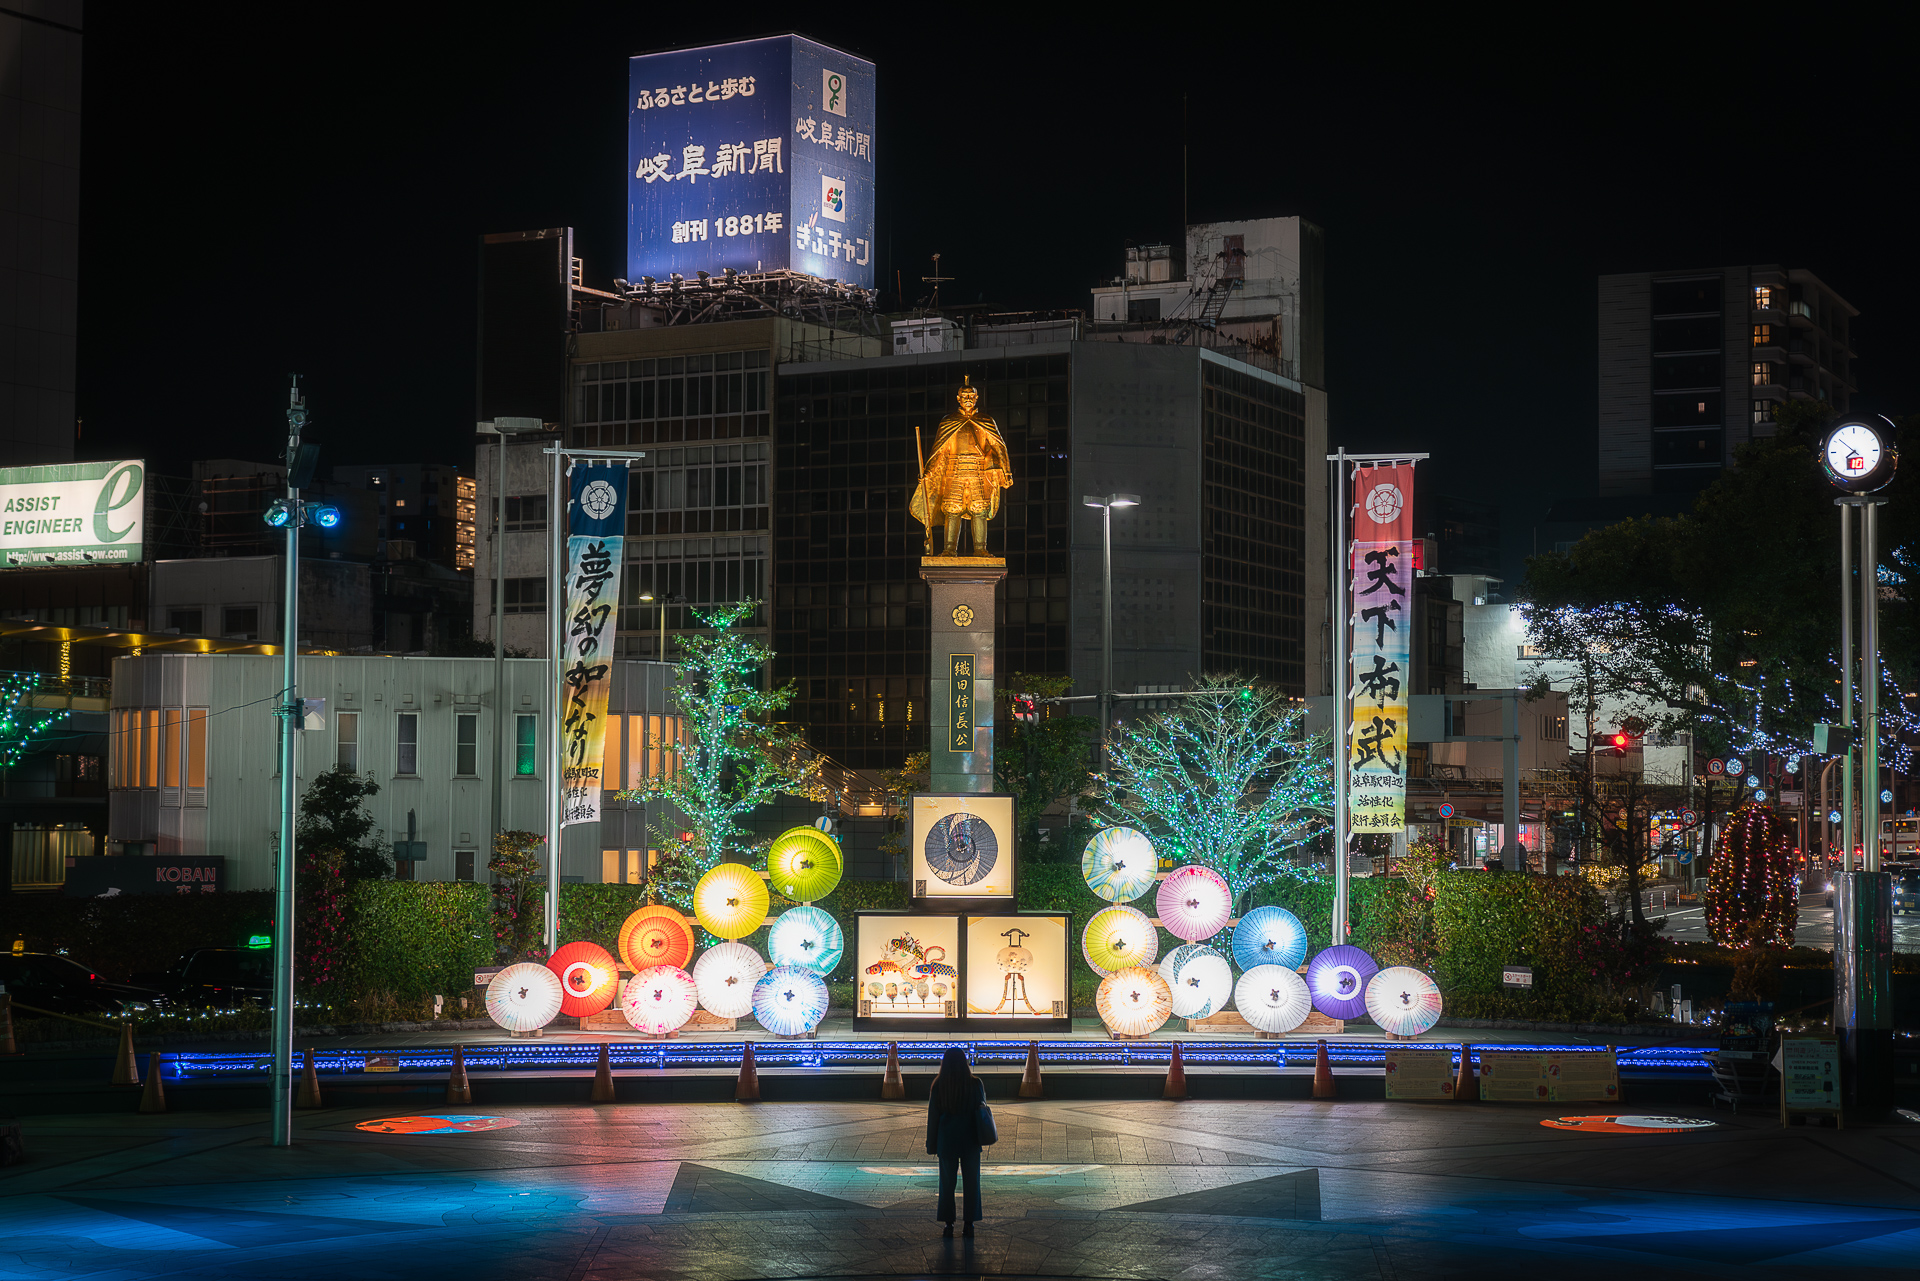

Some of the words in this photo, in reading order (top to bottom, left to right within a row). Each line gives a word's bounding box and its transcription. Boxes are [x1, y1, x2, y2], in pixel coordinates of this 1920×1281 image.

[637, 76, 756, 110] ふるさとと歩む
[795, 116, 871, 163] 岐阜新聞
[636, 136, 783, 184] 岐阜新聞
[671, 218, 708, 243] 創刊
[714, 212, 783, 238] 1881年
[796, 211, 869, 266] ぎふチャン
[4, 496, 60, 512] ASSIST
[3, 518, 83, 535] ENGINEER
[6, 548, 128, 565] http://www.assistnow.com
[565, 541, 614, 766] 夢幻の如くなり
[1353, 546, 1406, 775] 天下布武
[954, 660, 971, 746] 織田信長公
[1352, 772, 1403, 789] 岐阜駅周辺
[1357, 794, 1394, 808] 活性化
[1352, 812, 1402, 828] 実行委員会
[156, 867, 216, 882] KOBAN
